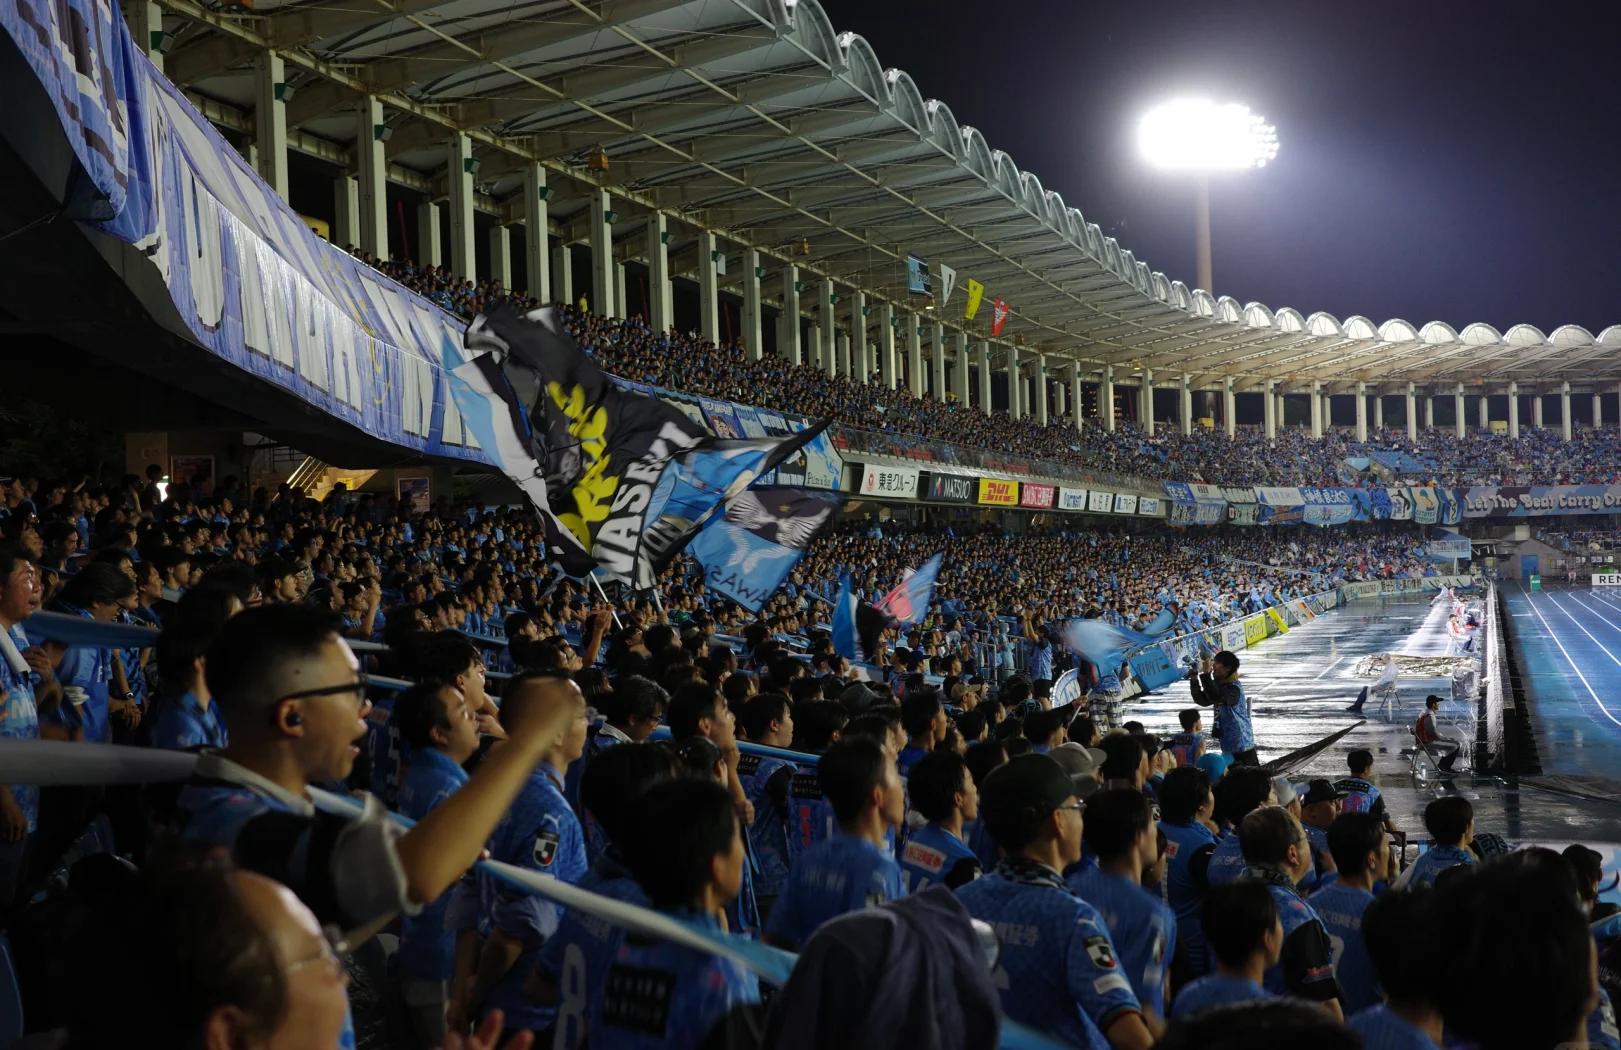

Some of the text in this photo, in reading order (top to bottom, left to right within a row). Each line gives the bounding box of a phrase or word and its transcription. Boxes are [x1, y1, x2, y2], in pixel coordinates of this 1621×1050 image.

[944, 478, 971, 499] MATSUO
[986, 482, 1012, 502] DHL
[1465, 494, 1488, 511] Let
[1488, 494, 1517, 509] The
[1519, 494, 1555, 510] Beat
[1558, 494, 1600, 511] Carry
